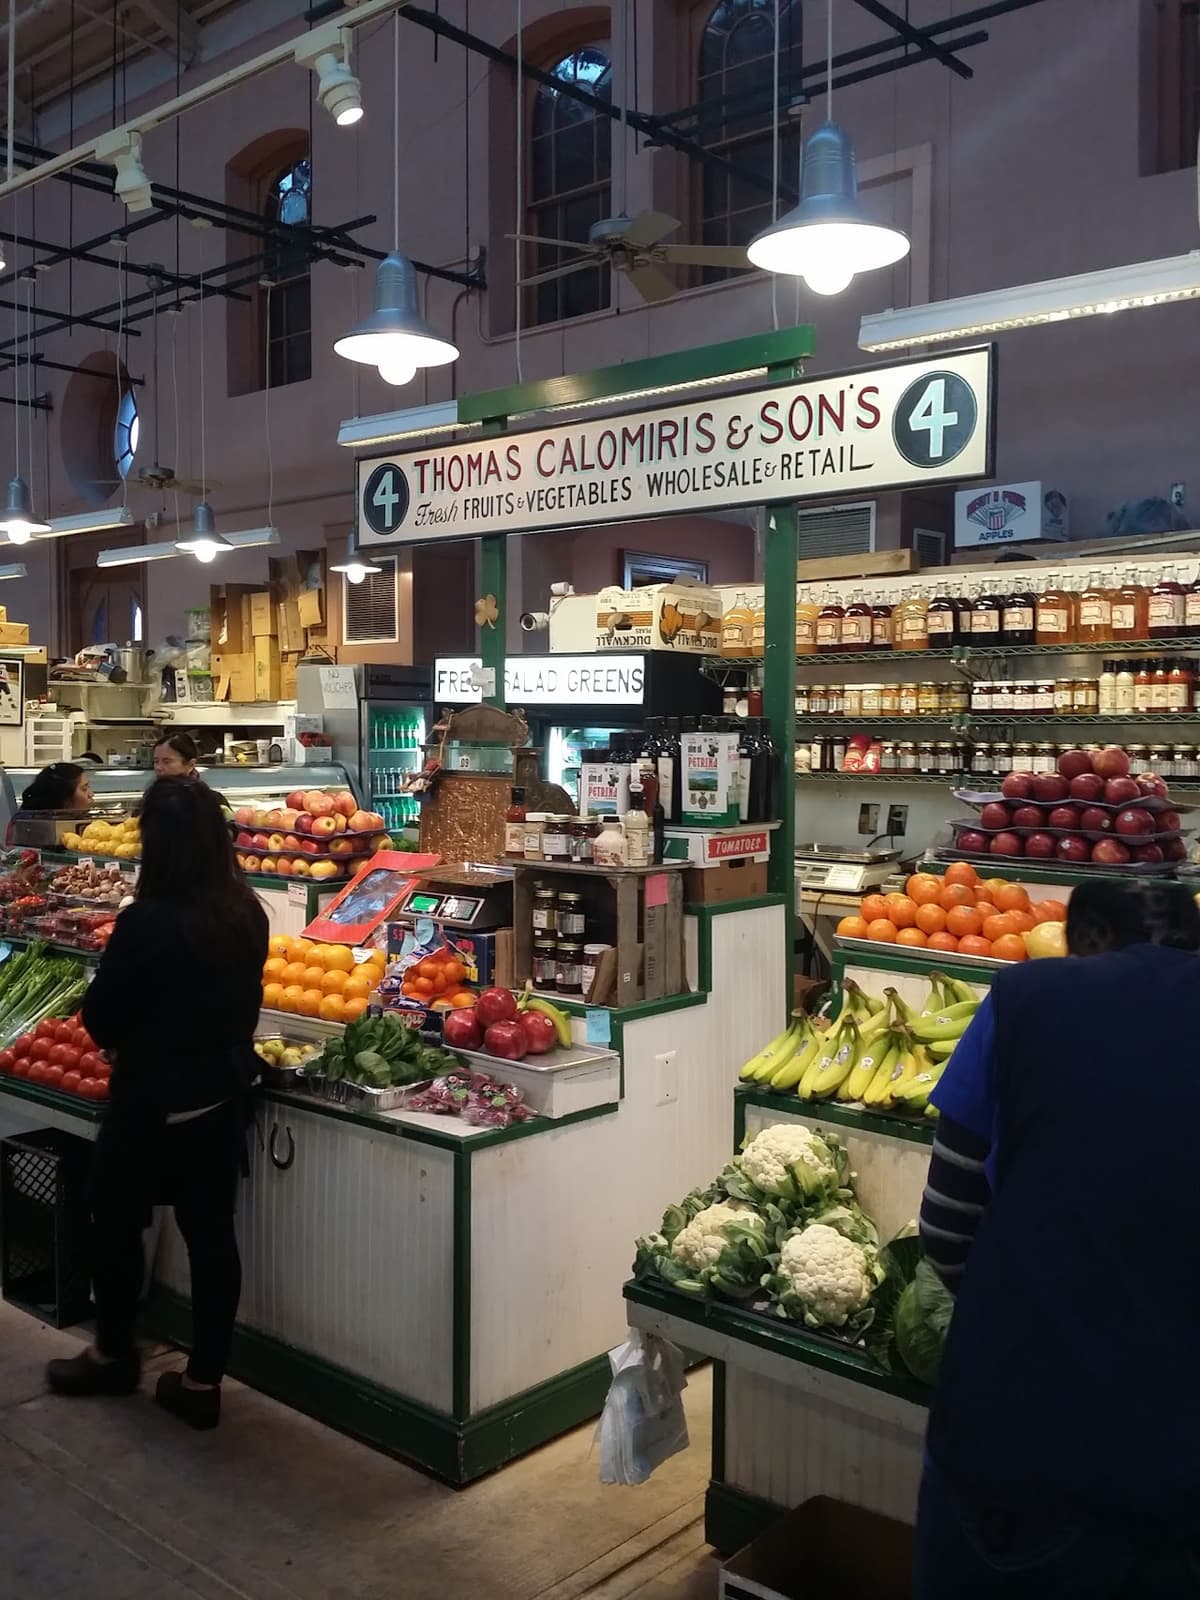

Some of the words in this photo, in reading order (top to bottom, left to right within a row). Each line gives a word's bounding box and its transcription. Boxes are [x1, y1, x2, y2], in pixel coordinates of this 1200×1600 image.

[414, 445, 521, 493] THOMAS
[537, 413, 716, 477] CALOMIRIS
[727, 416, 753, 449] &
[760, 384, 880, 443] SON'S
[909, 379, 958, 458] 4
[373, 471, 399, 527] 4
[415, 500, 459, 527] Fresh
[464, 493, 514, 520] FRUITS
[526, 476, 632, 512] VEGETABLES
[647, 457, 762, 497] WHOLESALE
[780, 444, 874, 480] RETAIL
[979, 529, 1014, 541] APPLES
[596, 636, 651, 647] DUCKWALL
[438, 670, 481, 693] FRE
[568, 668, 643, 693] GREENS
[716, 837, 761, 854] TOMATOES
